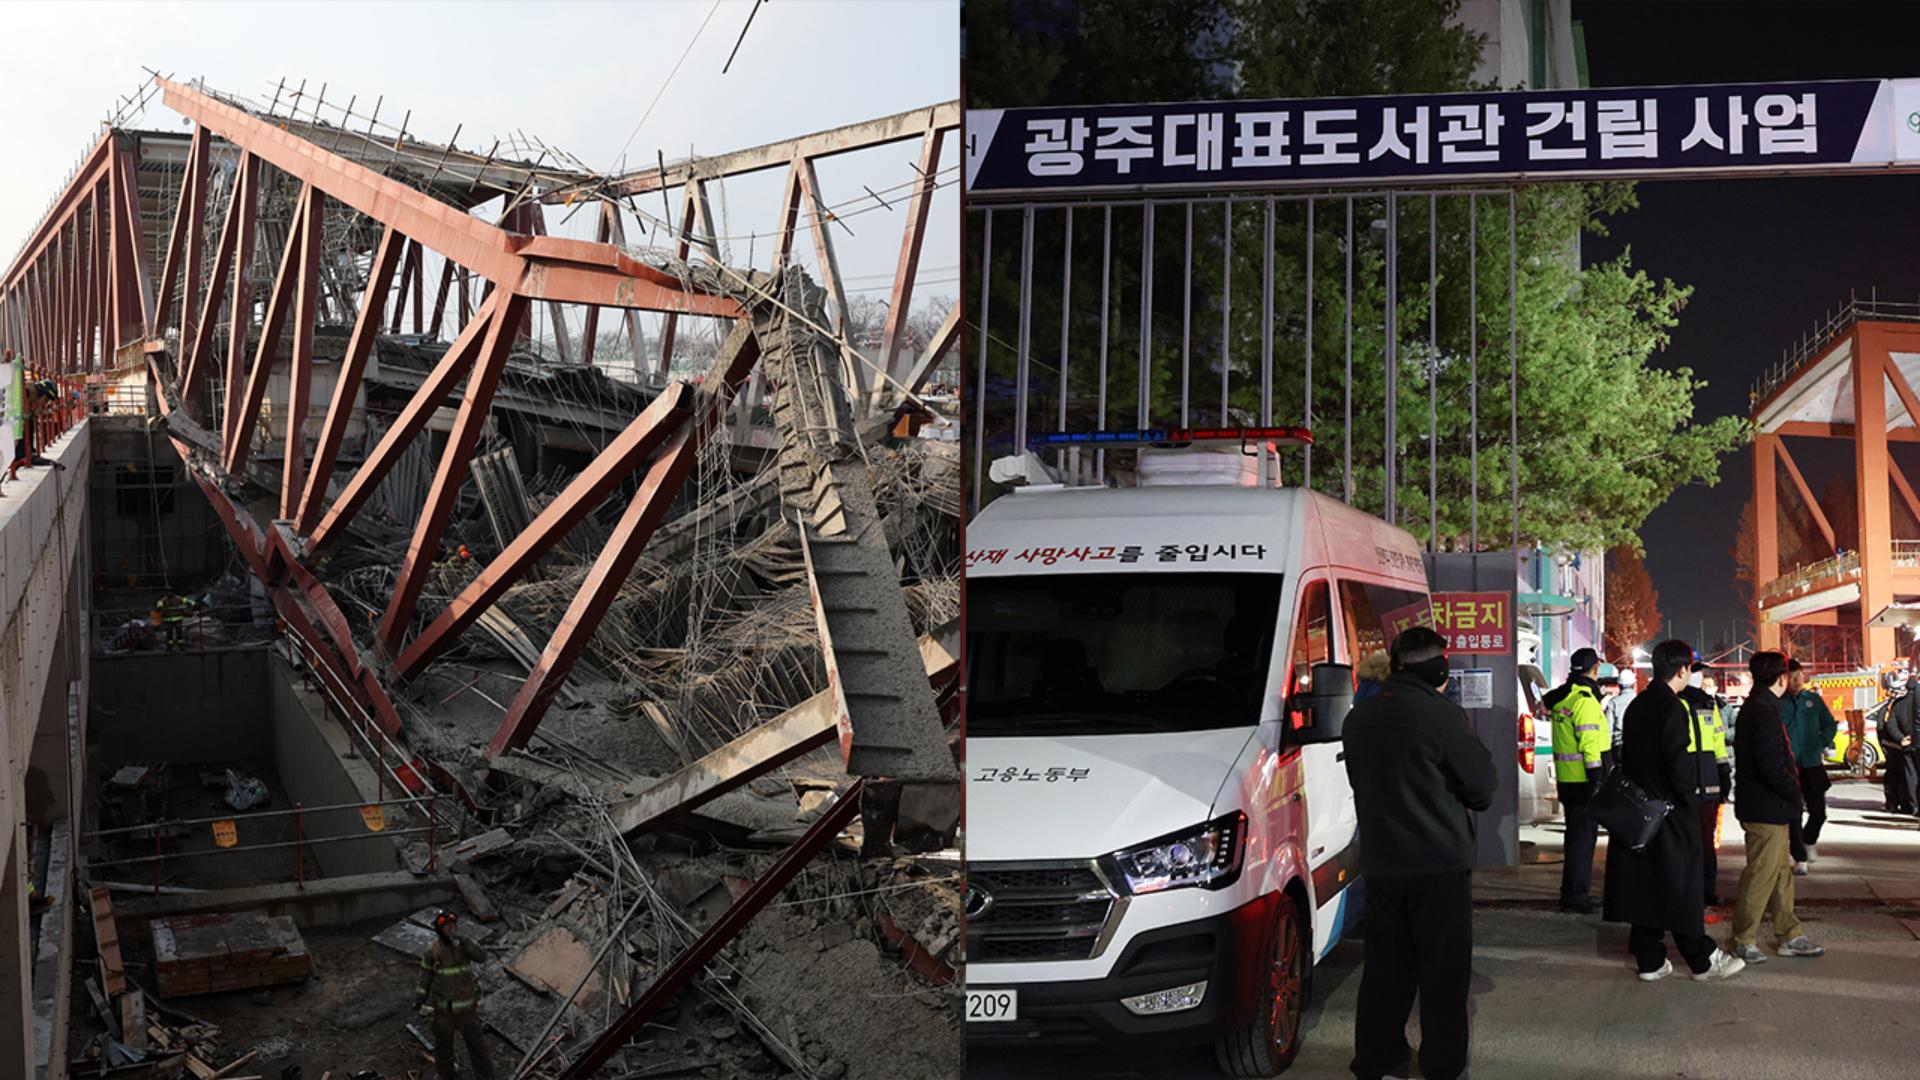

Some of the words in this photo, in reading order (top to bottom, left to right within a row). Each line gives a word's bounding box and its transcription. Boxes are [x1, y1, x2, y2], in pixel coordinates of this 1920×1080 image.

[1024, 103, 1505, 177] 광주대표도서관
[1526, 98, 1659, 161] 건립
[1681, 92, 1818, 156] 사업
[966, 548, 1009, 568] 산재
[1014, 545, 1145, 566] 사망사고를
[1155, 543, 1267, 562] 줄입시다
[973, 766, 1091, 783] 고용노동부
[966, 993, 1011, 1018] 209
